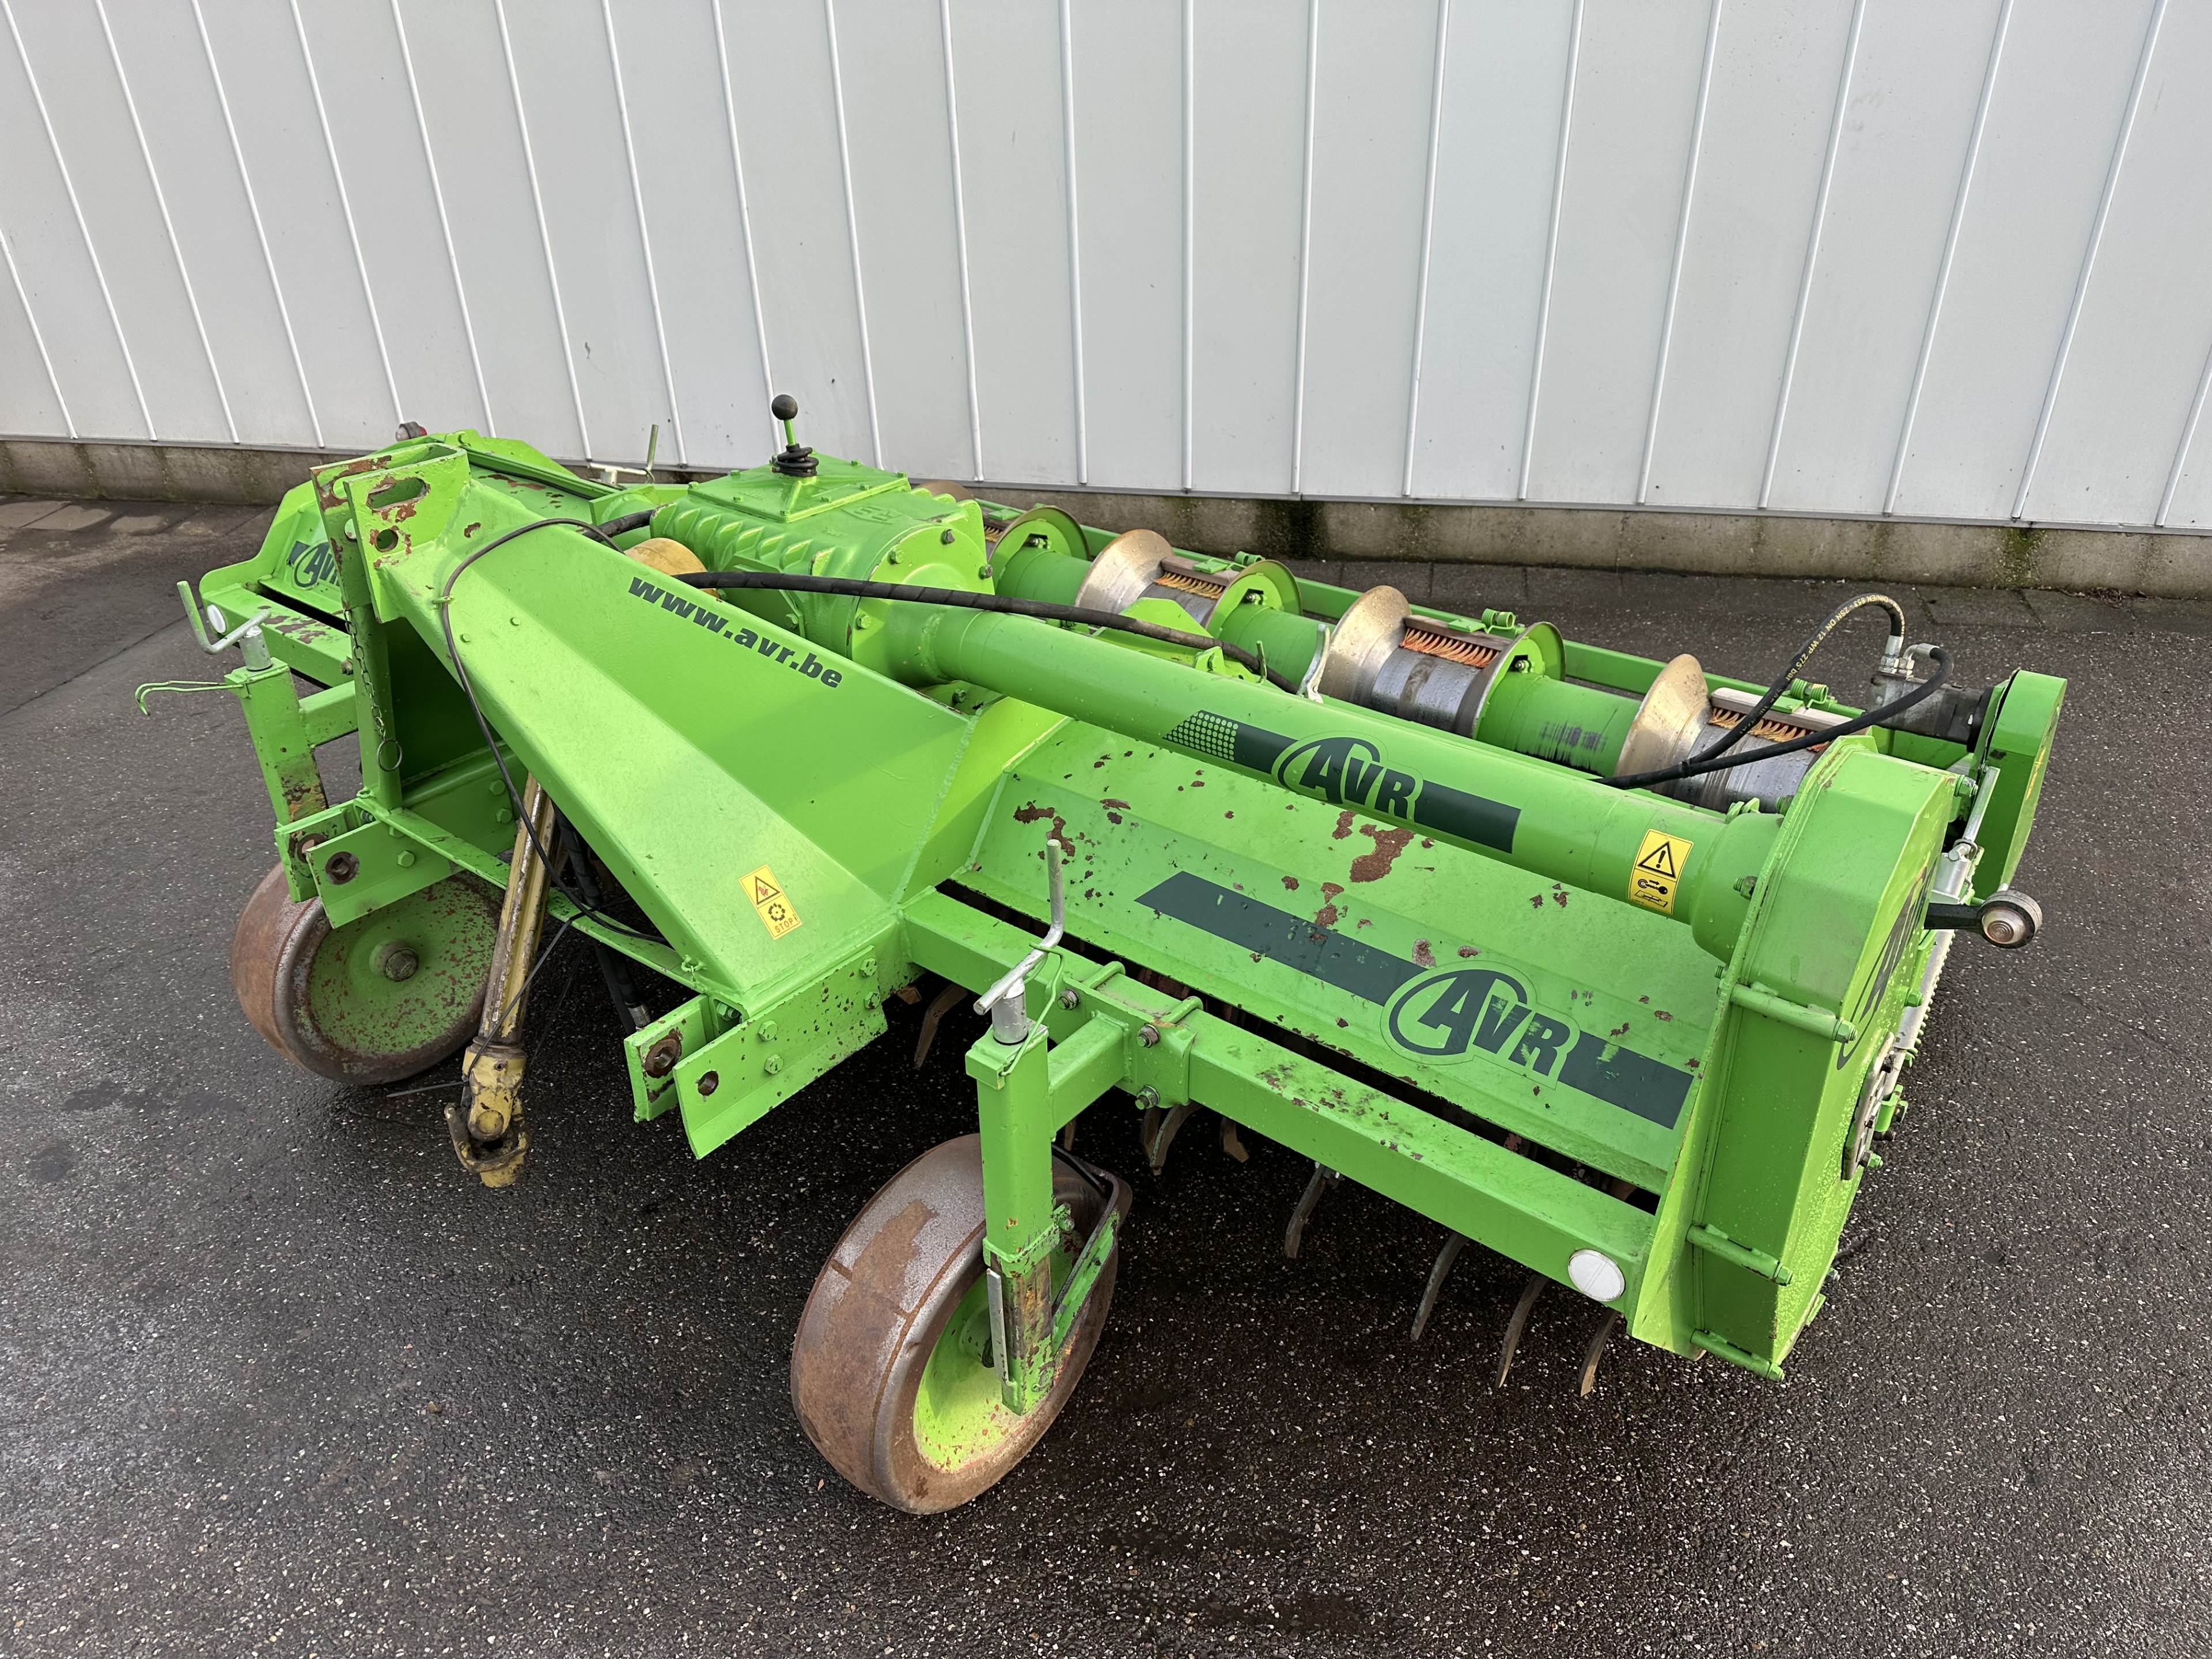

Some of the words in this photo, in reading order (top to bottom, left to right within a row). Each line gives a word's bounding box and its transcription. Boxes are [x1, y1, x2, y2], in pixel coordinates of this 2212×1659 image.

[1853, 597, 1866, 608] 853
[1835, 607, 1850, 622] 2SN
[628, 576, 842, 688] www.avr.be
[1825, 619, 1837, 632] DN
[1817, 631, 1827, 641] 12
[1808, 640, 1820, 654] WP
[1786, 668, 1798, 681] bar
[1278, 737, 1416, 820] AVR
[775, 918, 793, 933] STOP
[1388, 969, 1571, 1077] AVR
